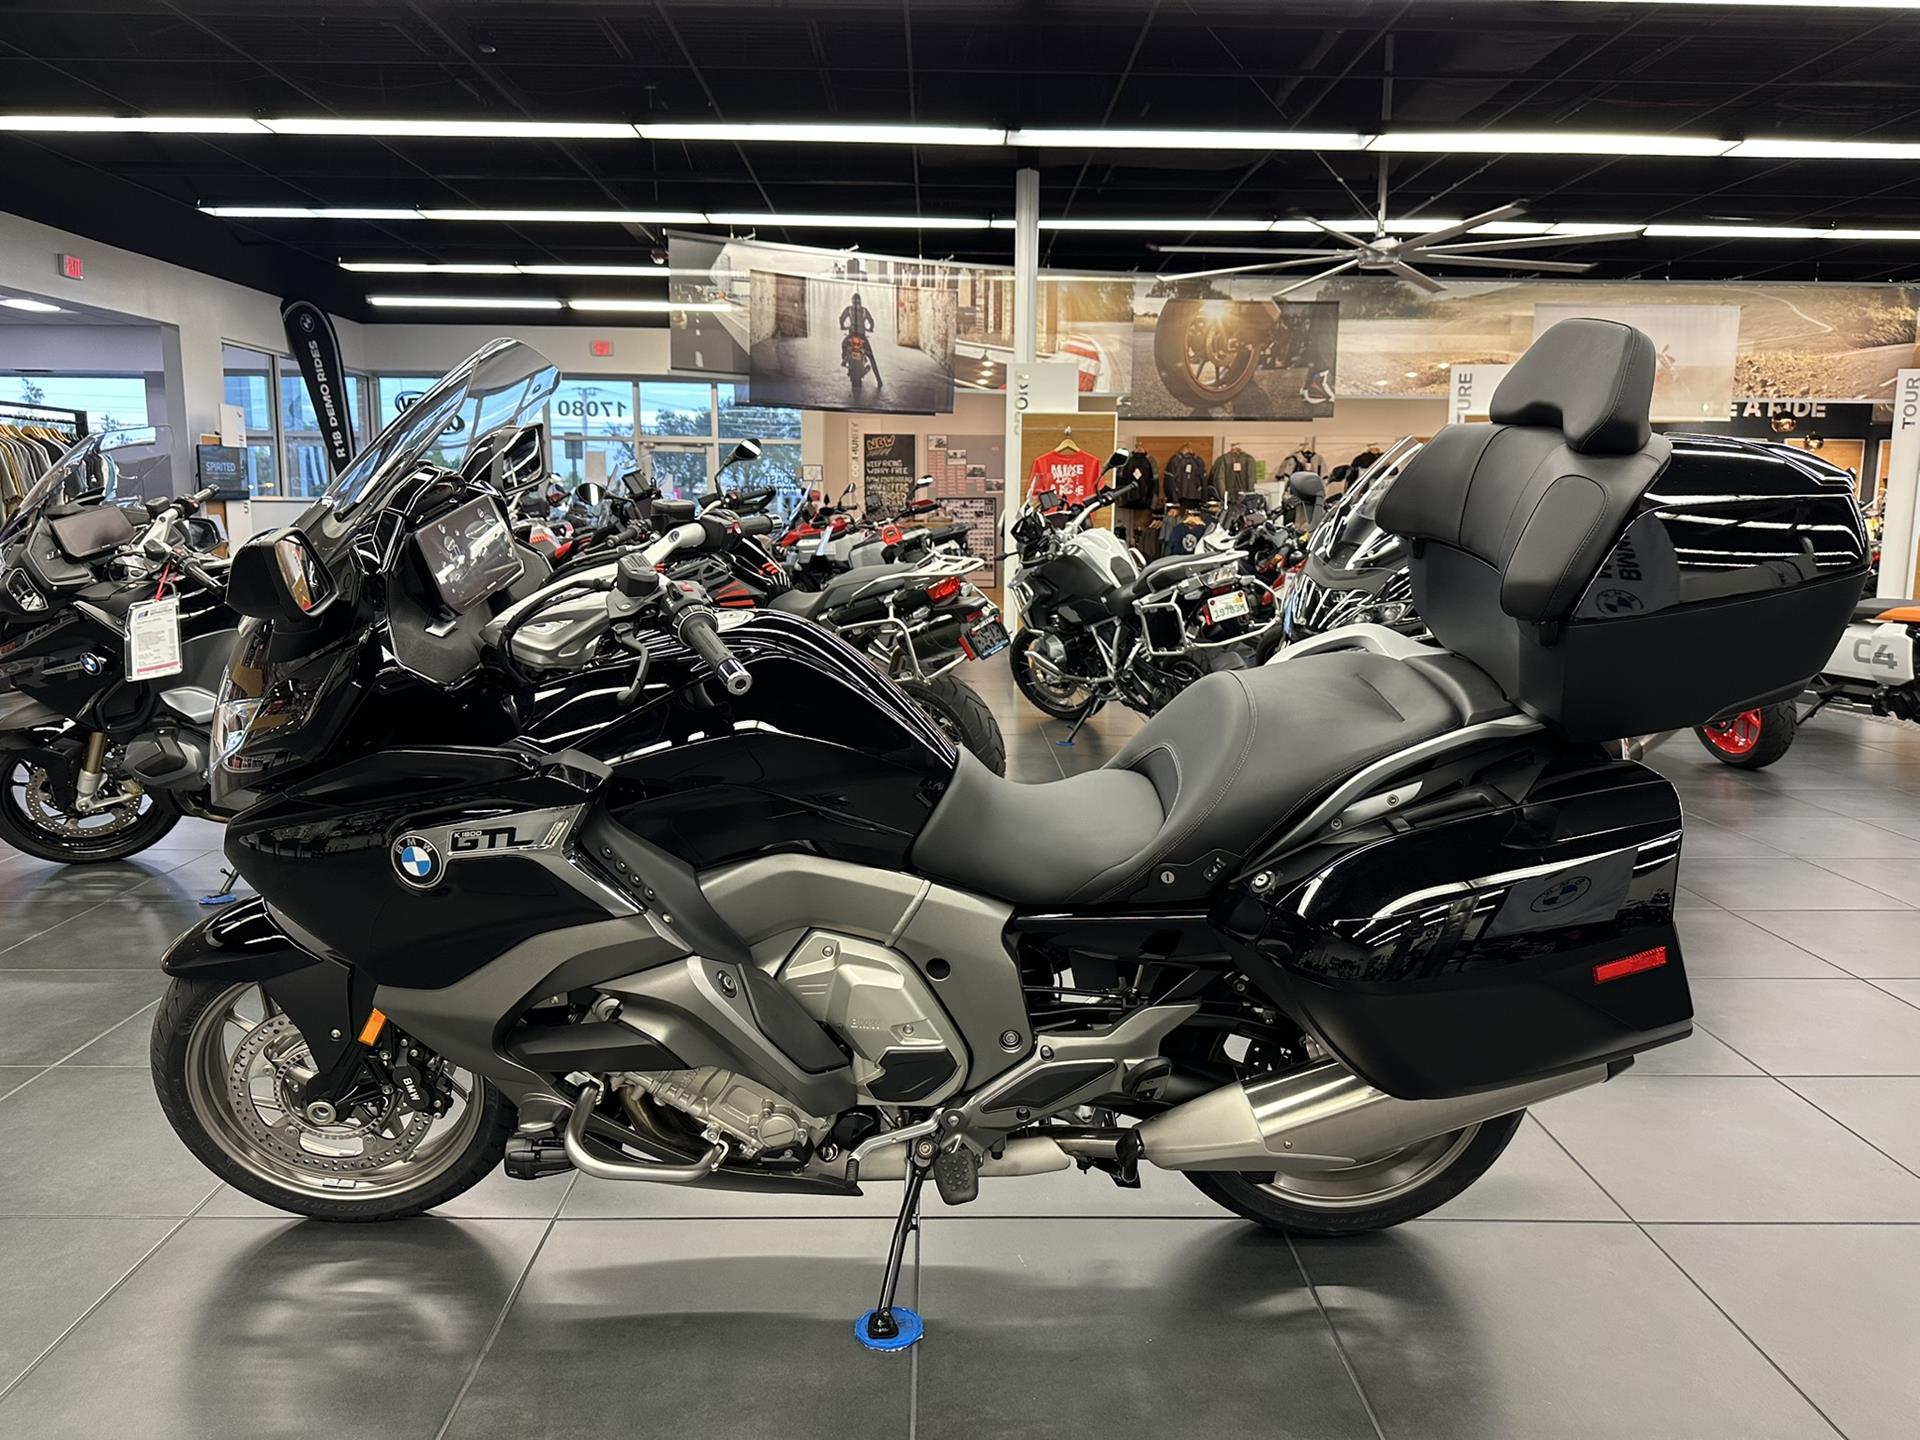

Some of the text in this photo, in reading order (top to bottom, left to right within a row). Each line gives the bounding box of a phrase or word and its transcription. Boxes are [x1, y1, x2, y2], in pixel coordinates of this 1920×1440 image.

[308, 340, 346, 458] R 18 DEMO RIDES
[1742, 399, 1761, 417] A
[1902, 378, 1920, 430] TOUR
[866, 435, 895, 450] NEW
[206, 462, 236, 473] SPIRITED
[396, 838, 433, 855] BMW
[451, 827, 534, 851] GTL
[402, 1077, 420, 1100] BMW
